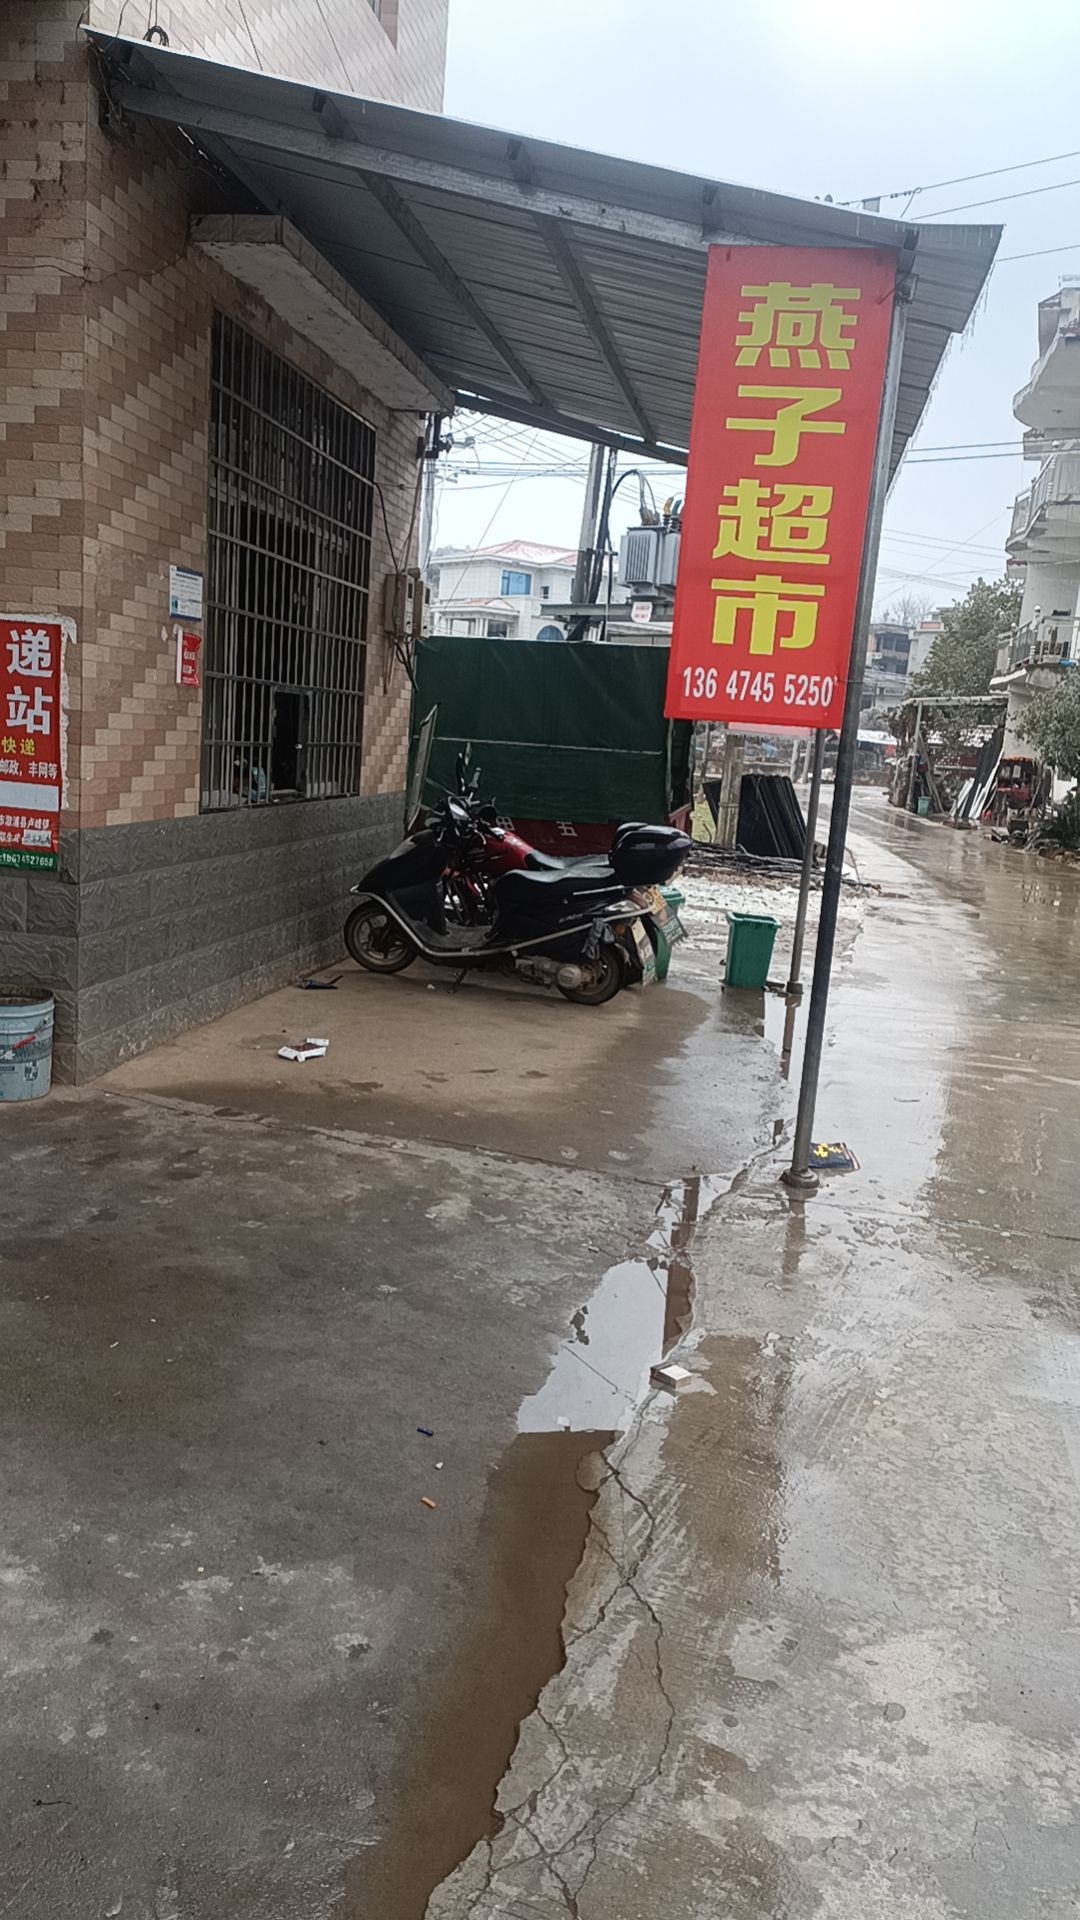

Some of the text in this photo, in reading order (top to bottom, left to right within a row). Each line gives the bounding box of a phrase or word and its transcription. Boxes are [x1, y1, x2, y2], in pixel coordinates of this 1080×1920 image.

[711, 281, 862, 656] 燕子超市
[683, 666, 834, 707] 136 4745 5250
[1, 735, 36, 756] 快递
